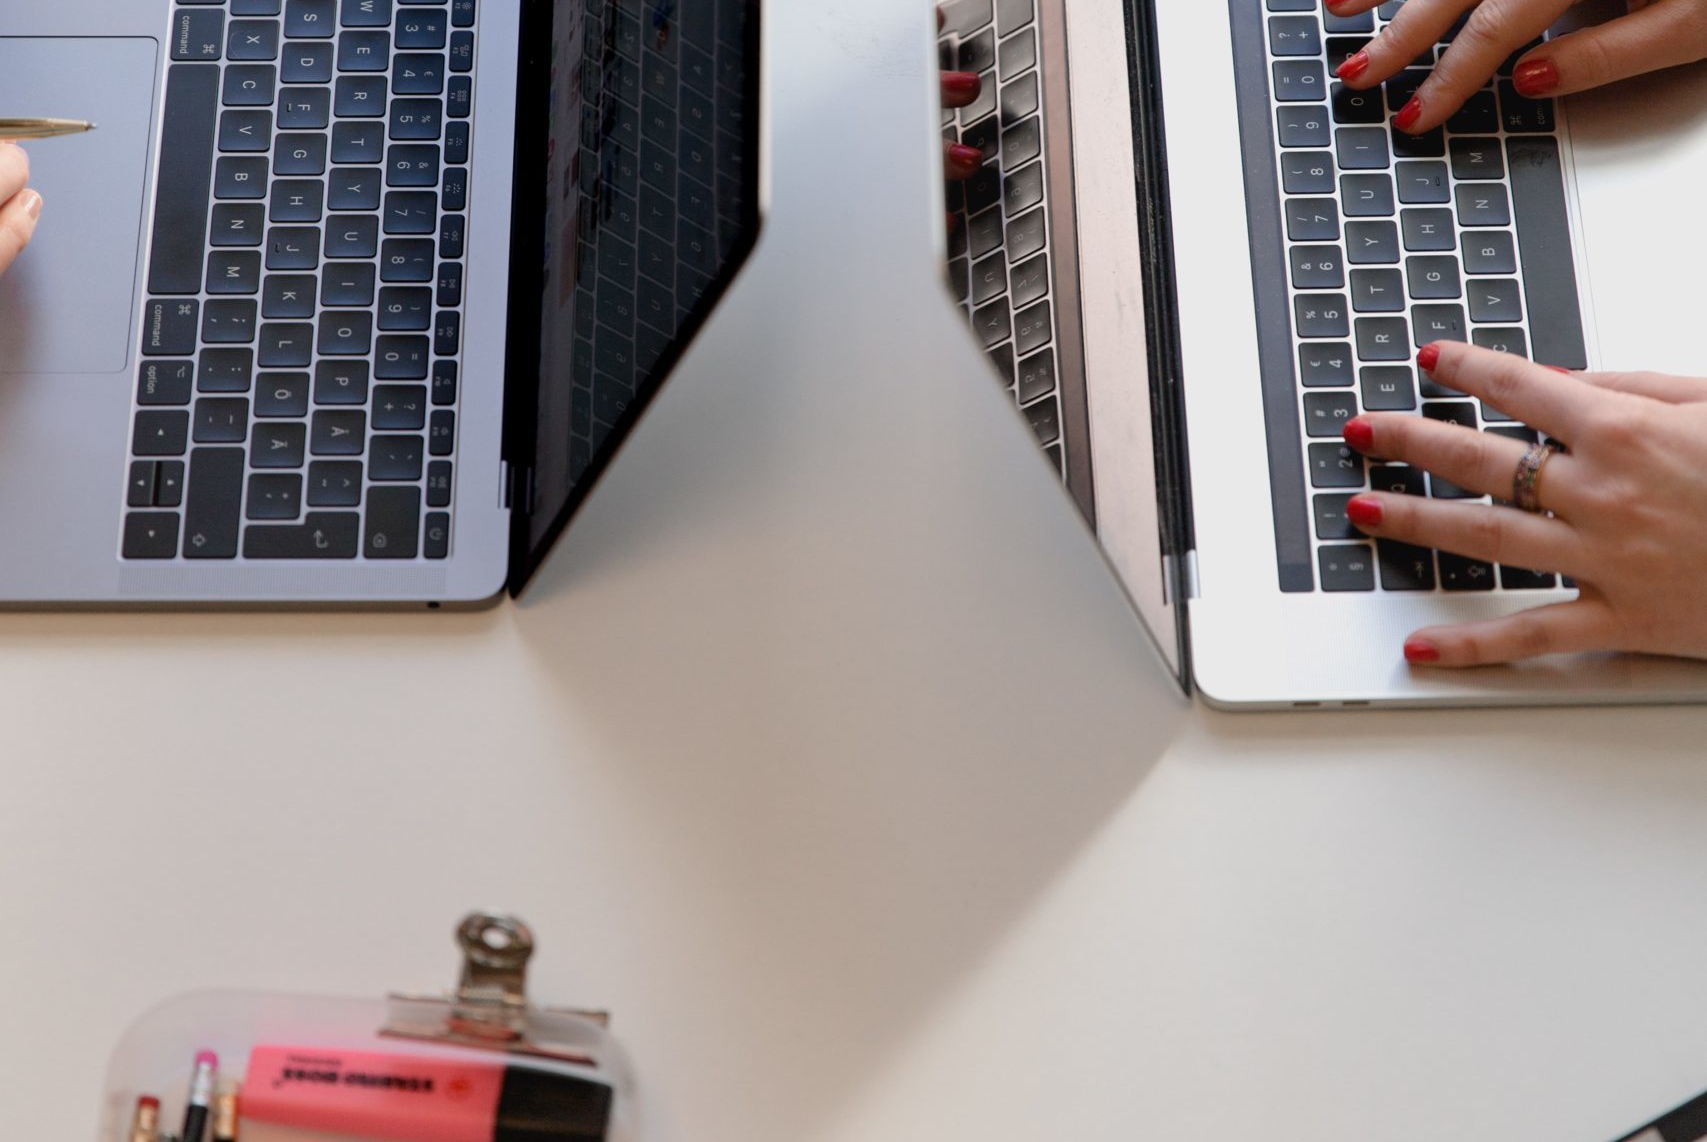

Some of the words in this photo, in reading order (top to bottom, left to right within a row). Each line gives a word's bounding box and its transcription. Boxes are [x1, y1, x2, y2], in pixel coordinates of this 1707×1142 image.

[360, 1, 373, 12] W
[180, 16, 189, 53] command
[301, 58, 313, 66] D
[1351, 98, 1363, 106] O
[240, 126, 252, 134] V
[352, 138, 364, 146] T
[294, 150, 307, 158] G
[1470, 153, 1483, 162] M
[235, 173, 248, 181] B
[290, 197, 303, 205] H
[1476, 200, 1488, 208] N
[231, 220, 244, 228] N
[1421, 225, 1434, 233] H
[345, 232, 357, 240] U
[1365, 238, 1378, 246] Y
[392, 256, 405, 264] 8
[227, 267, 240, 277] M
[1427, 273, 1440, 281] G
[1370, 286, 1384, 294] T
[283, 292, 296, 300] K
[1488, 296, 1500, 304] V
[152, 305, 162, 346] command
[338, 328, 351, 337] O
[1329, 360, 1342, 368] 4
[147, 366, 156, 393] option
[335, 377, 348, 386] P
[275, 390, 291, 399] Ö
[1334, 409, 1348, 417] 3
[332, 427, 349, 436] Å
[271, 440, 287, 449] Ä
[1338, 460, 1352, 468] 2
